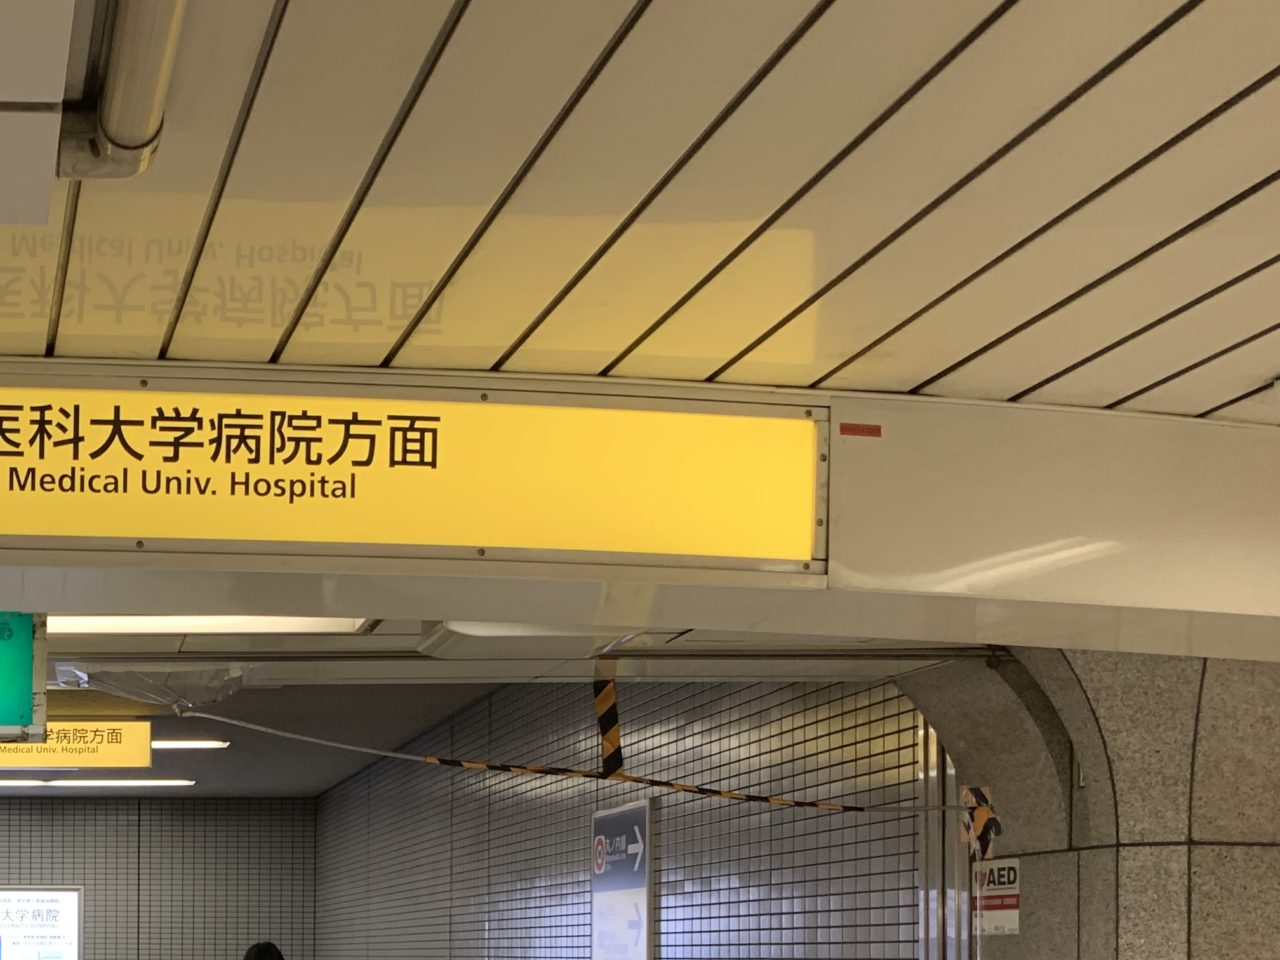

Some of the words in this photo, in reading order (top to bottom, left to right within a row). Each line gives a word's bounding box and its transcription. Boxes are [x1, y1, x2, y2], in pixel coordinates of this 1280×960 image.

[8, 467, 127, 494] Medical
[142, 470, 218, 496] Univ.
[230, 474, 356, 504] Hospital
[0, 745, 33, 754] Medical
[36, 745, 59, 754] Univ.
[62, 745, 99, 756] Hospital
[986, 866, 1017, 887] AED
